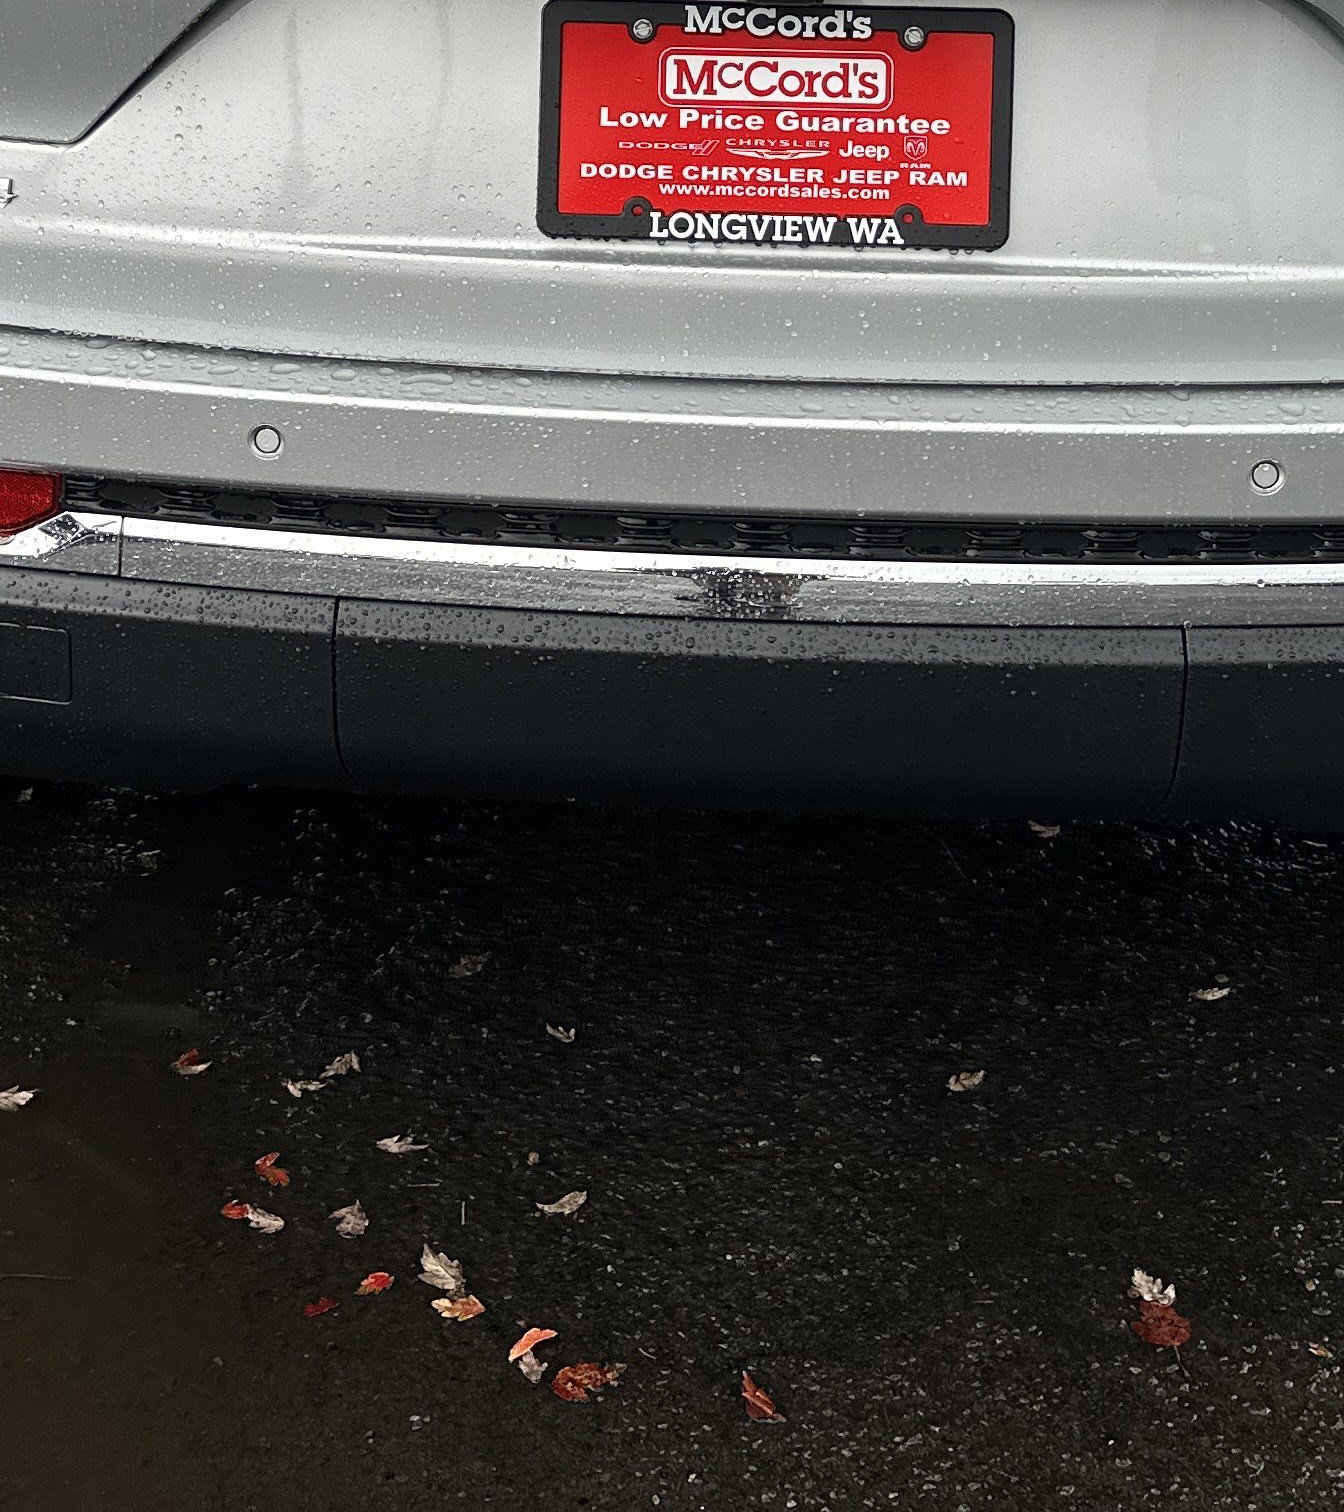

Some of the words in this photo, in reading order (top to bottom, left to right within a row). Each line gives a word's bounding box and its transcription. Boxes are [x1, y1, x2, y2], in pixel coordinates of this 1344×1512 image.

[685, 5, 872, 39] McCord's
[673, 59, 879, 99] McCord's
[600, 107, 667, 128] Low
[678, 108, 764, 130] Price
[776, 110, 951, 135] Guarantee
[618, 141, 703, 150] DODGE
[726, 137, 831, 148] CHRYSLER
[839, 140, 890, 161] Jeep
[581, 163, 673, 179] DODGE
[683, 165, 824, 183] CHRYSLER
[833, 169, 900, 184] JEEP
[909, 171, 968, 186] RAM
[659, 183, 890, 200] www.mccordsales.com
[650, 212, 835, 243] LONGVIEW
[847, 217, 903, 244] WA
